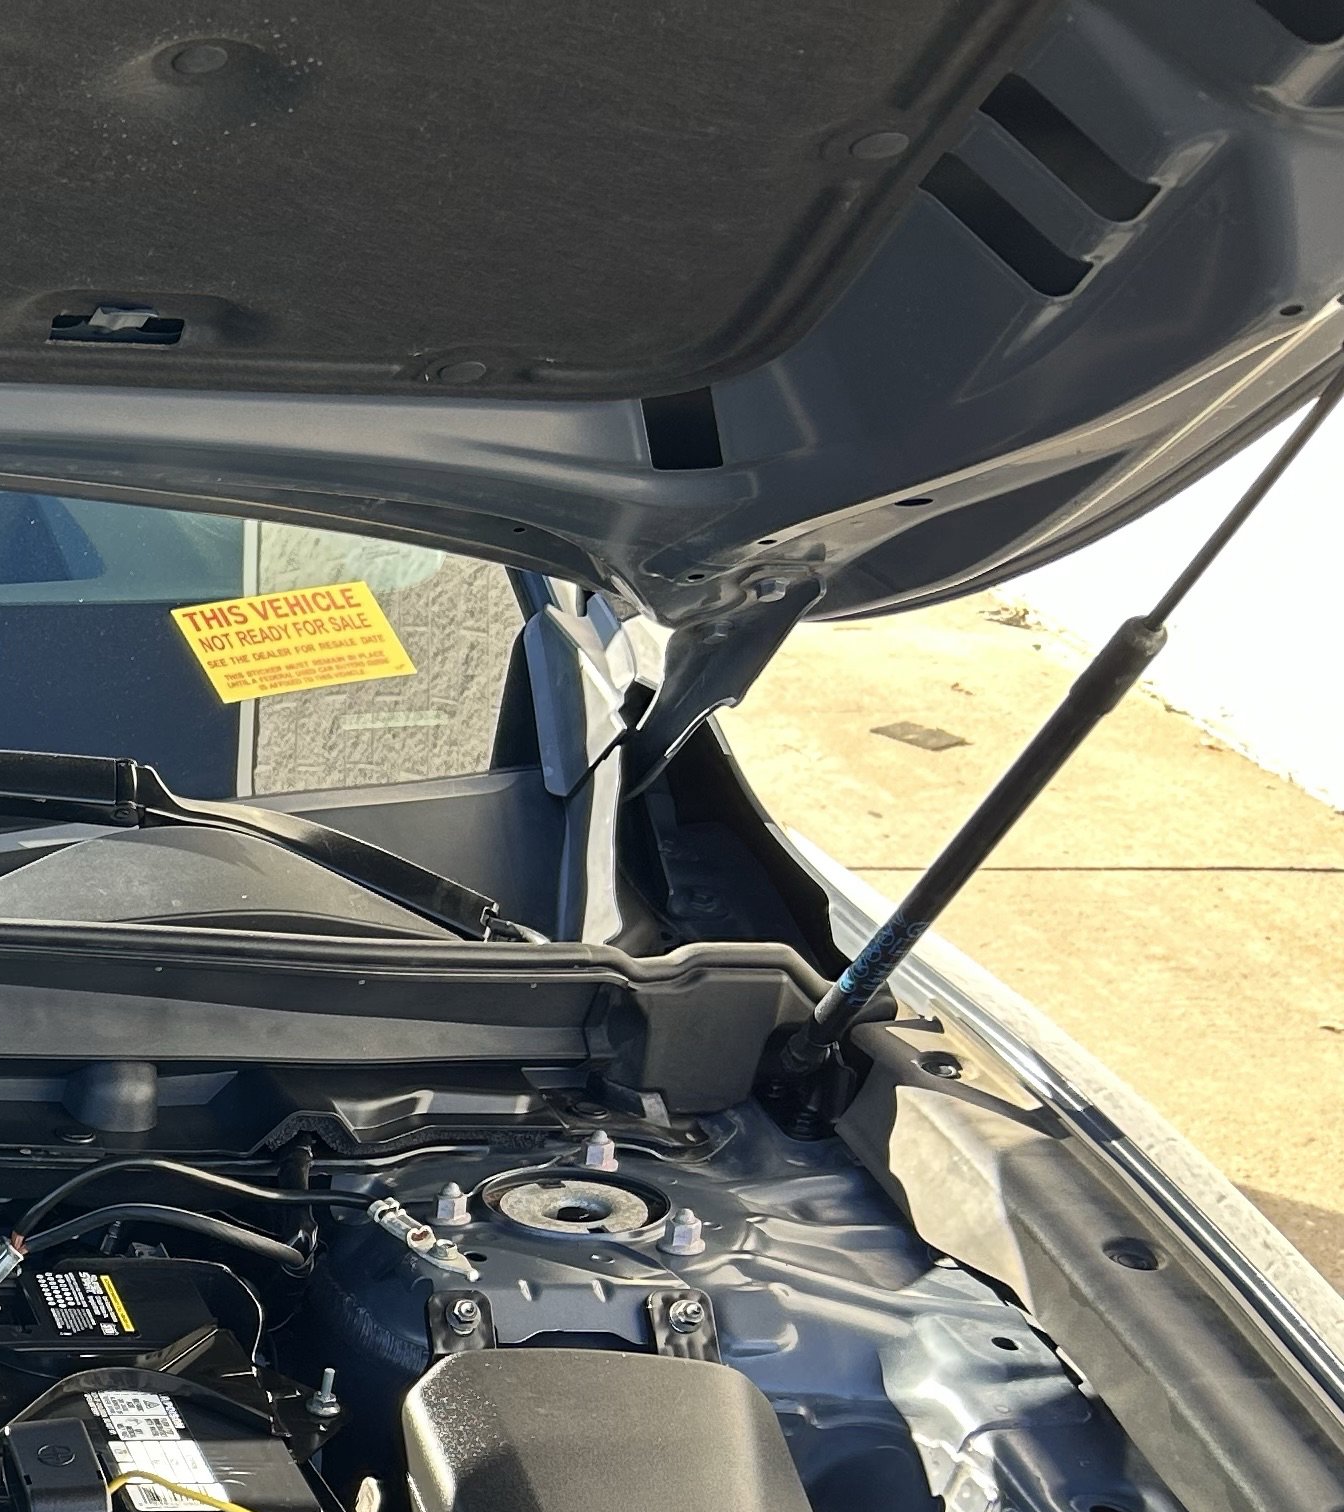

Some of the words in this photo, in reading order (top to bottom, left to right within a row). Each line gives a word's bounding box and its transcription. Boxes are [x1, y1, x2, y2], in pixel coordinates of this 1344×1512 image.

[182, 606, 248, 632] THIS
[248, 588, 361, 621] VEHICLE
[198, 633, 234, 653] NOT
[236, 624, 290, 647] READY
[292, 619, 329, 637] FOR
[328, 612, 372, 632] SALE
[207, 658, 228, 669] SEE
[230, 655, 250, 664] THE
[252, 648, 291, 660] DEALER
[294, 644, 316, 654] FOR
[318, 638, 357, 650] RESALE
[360, 634, 385, 645] DATE
[224, 672, 244, 680] THIS
[246, 666, 282, 677] STICKER
[285, 661, 309, 670] MUST
[358, 650, 385, 659] PLACE
[227, 680, 251, 688] UNTIL
[259, 672, 292, 682] FEDERAL
